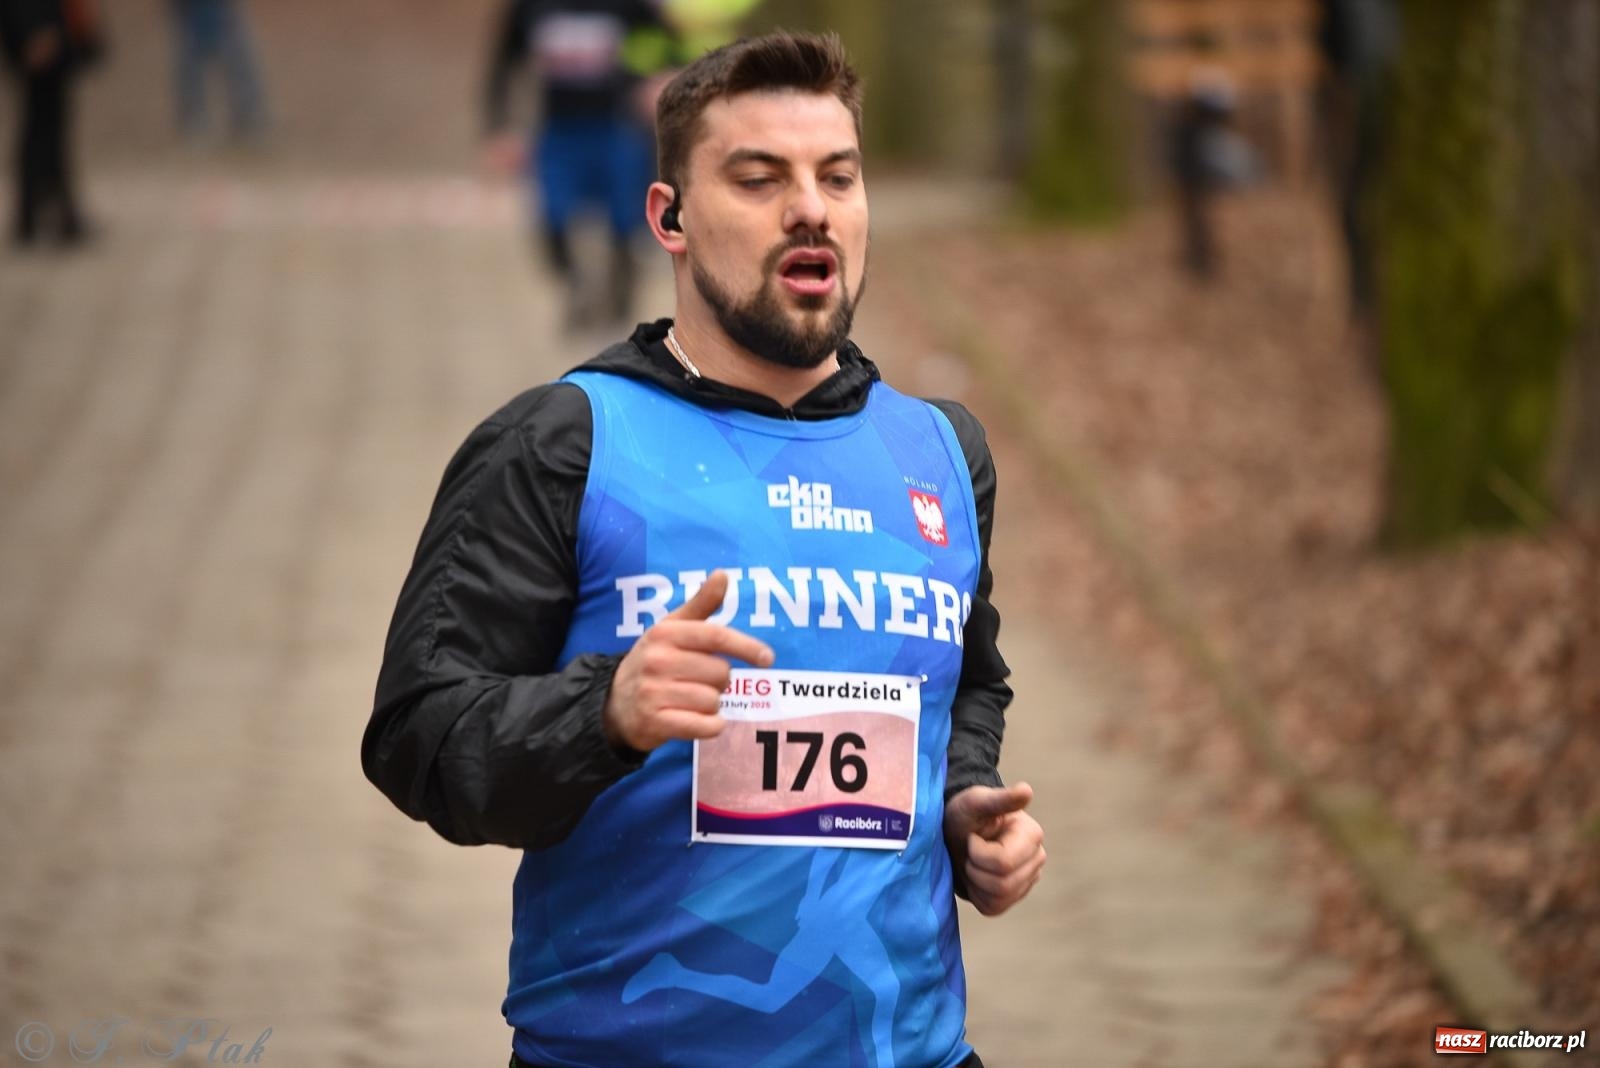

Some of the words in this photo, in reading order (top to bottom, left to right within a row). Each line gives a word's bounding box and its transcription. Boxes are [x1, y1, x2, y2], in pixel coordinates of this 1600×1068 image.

[767, 475, 832, 507] eko
[791, 506, 873, 534] okna
[779, 680, 901, 701] Twardziela
[731, 700, 748, 709] luty
[755, 729, 868, 794] 176
[835, 815, 882, 831] Racibórz
